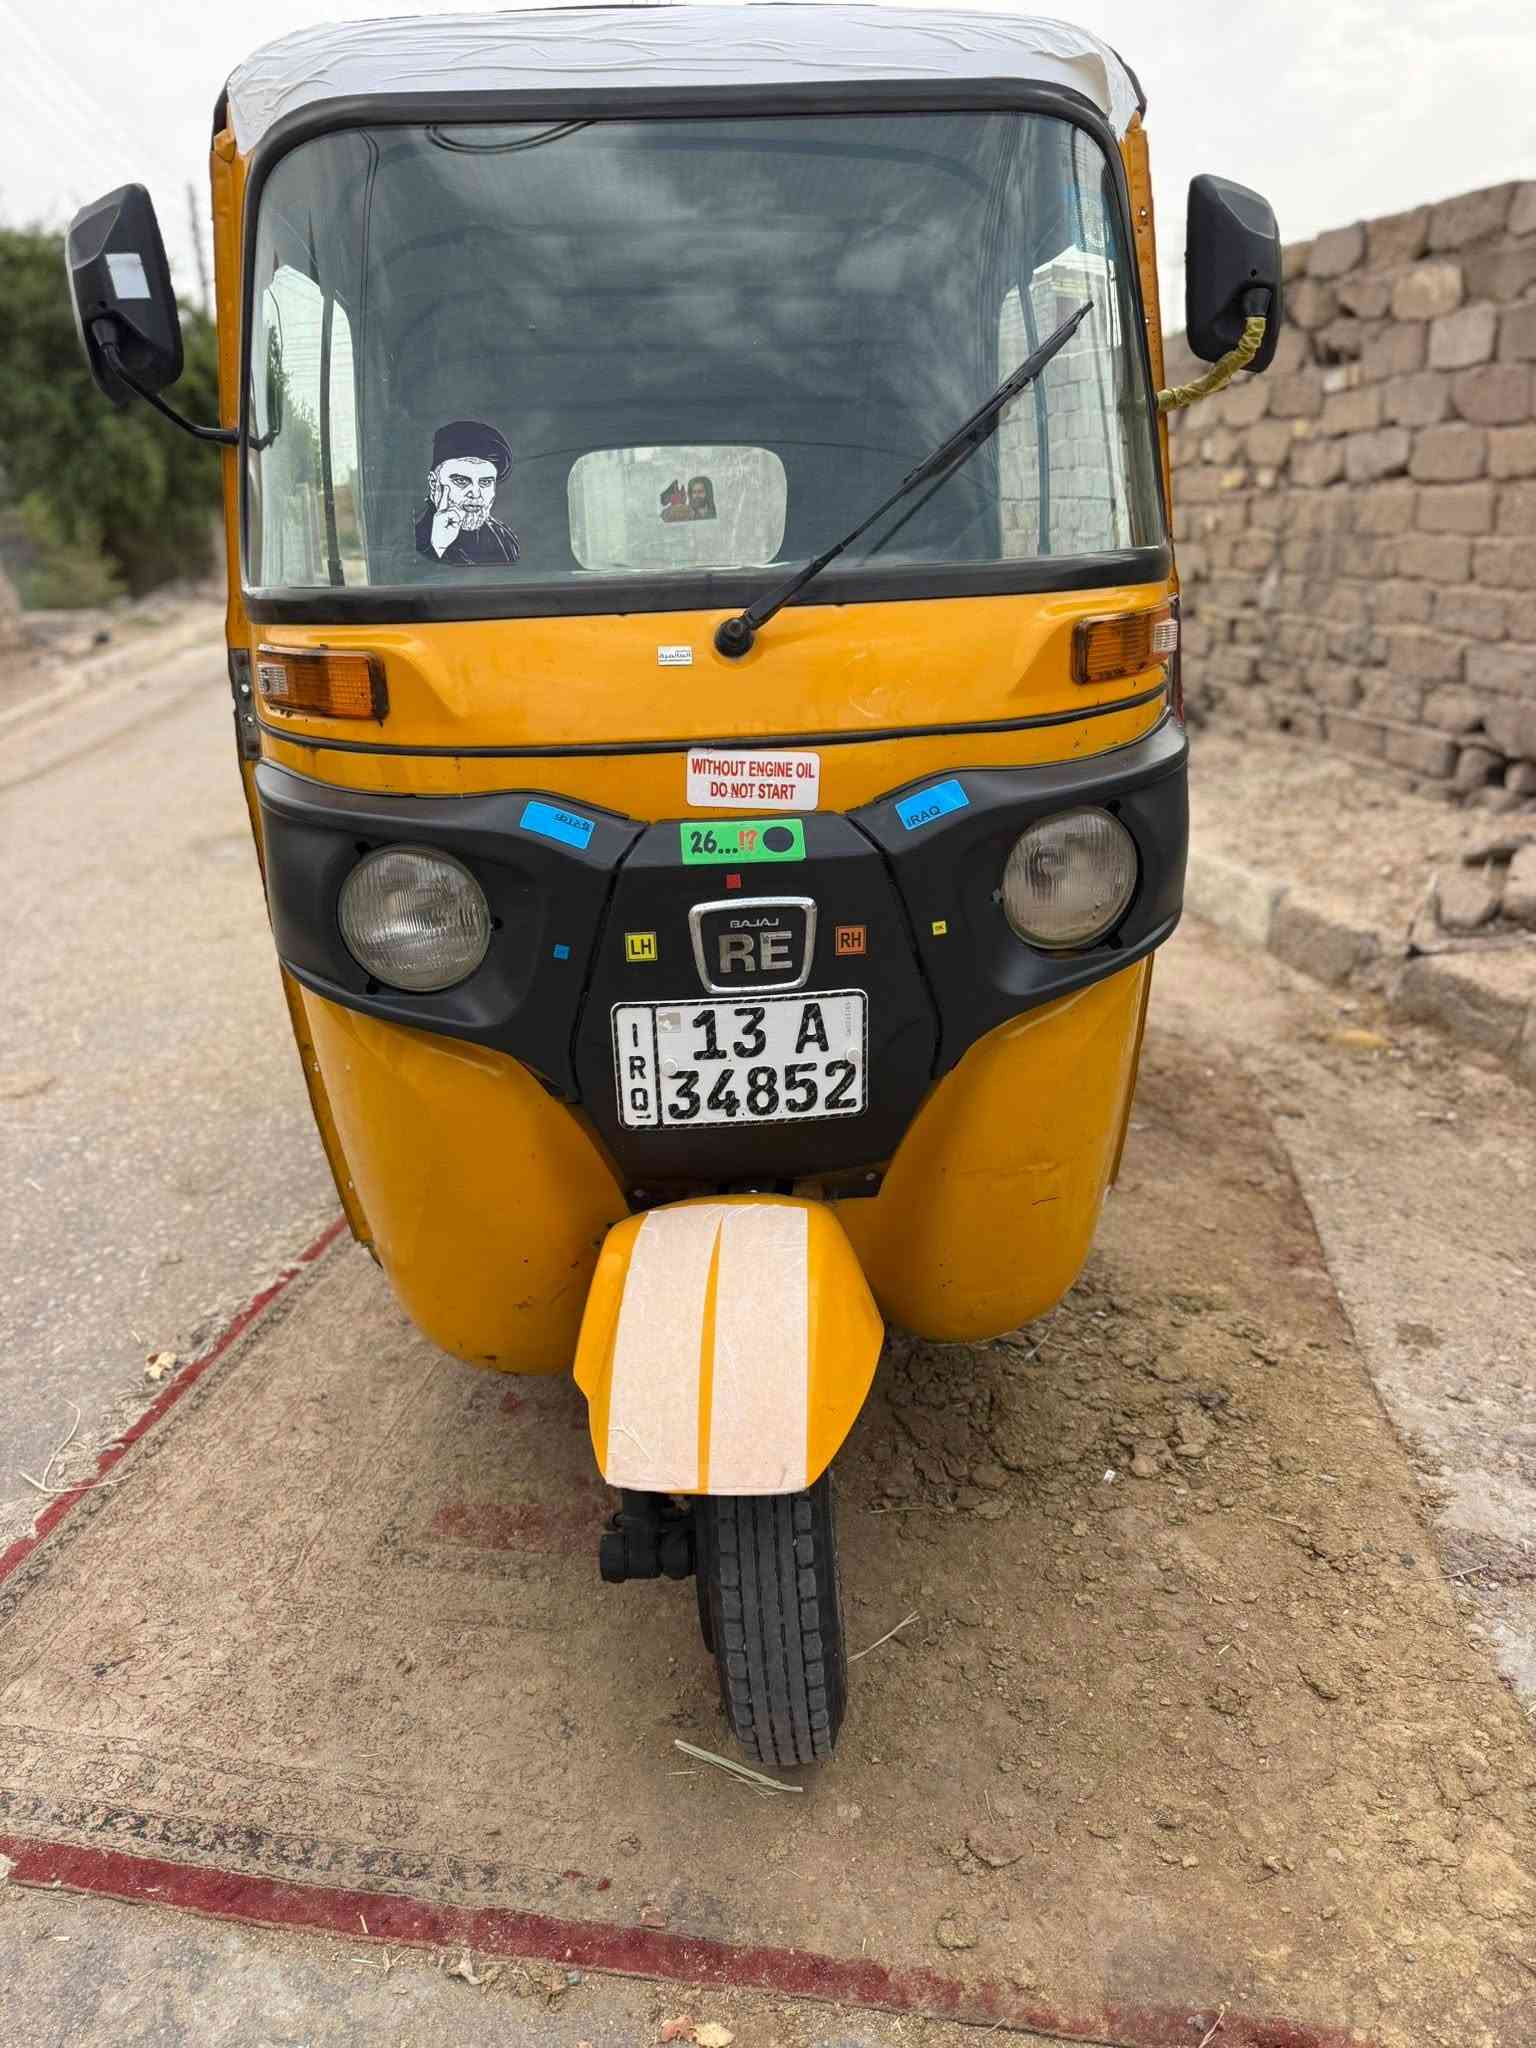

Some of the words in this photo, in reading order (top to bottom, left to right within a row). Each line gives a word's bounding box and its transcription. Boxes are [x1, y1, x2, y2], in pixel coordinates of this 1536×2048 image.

[691, 758, 746, 777] WITHOUT
[748, 760, 793, 778] ENGINE
[796, 762, 815, 778] OIL
[710, 782, 728, 797] DO
[730, 783, 755, 798] NOT
[758, 784, 796, 799] START
[906, 805, 941, 826] IRAQ
[730, 917, 779, 928] BAJAJ
[631, 938, 653, 956] LH
[840, 932, 862, 949] RH
[718, 930, 793, 973] RE
[692, 1006, 767, 1060] 13
[795, 1002, 830, 1054] A
[668, 1059, 858, 1120] 34852
